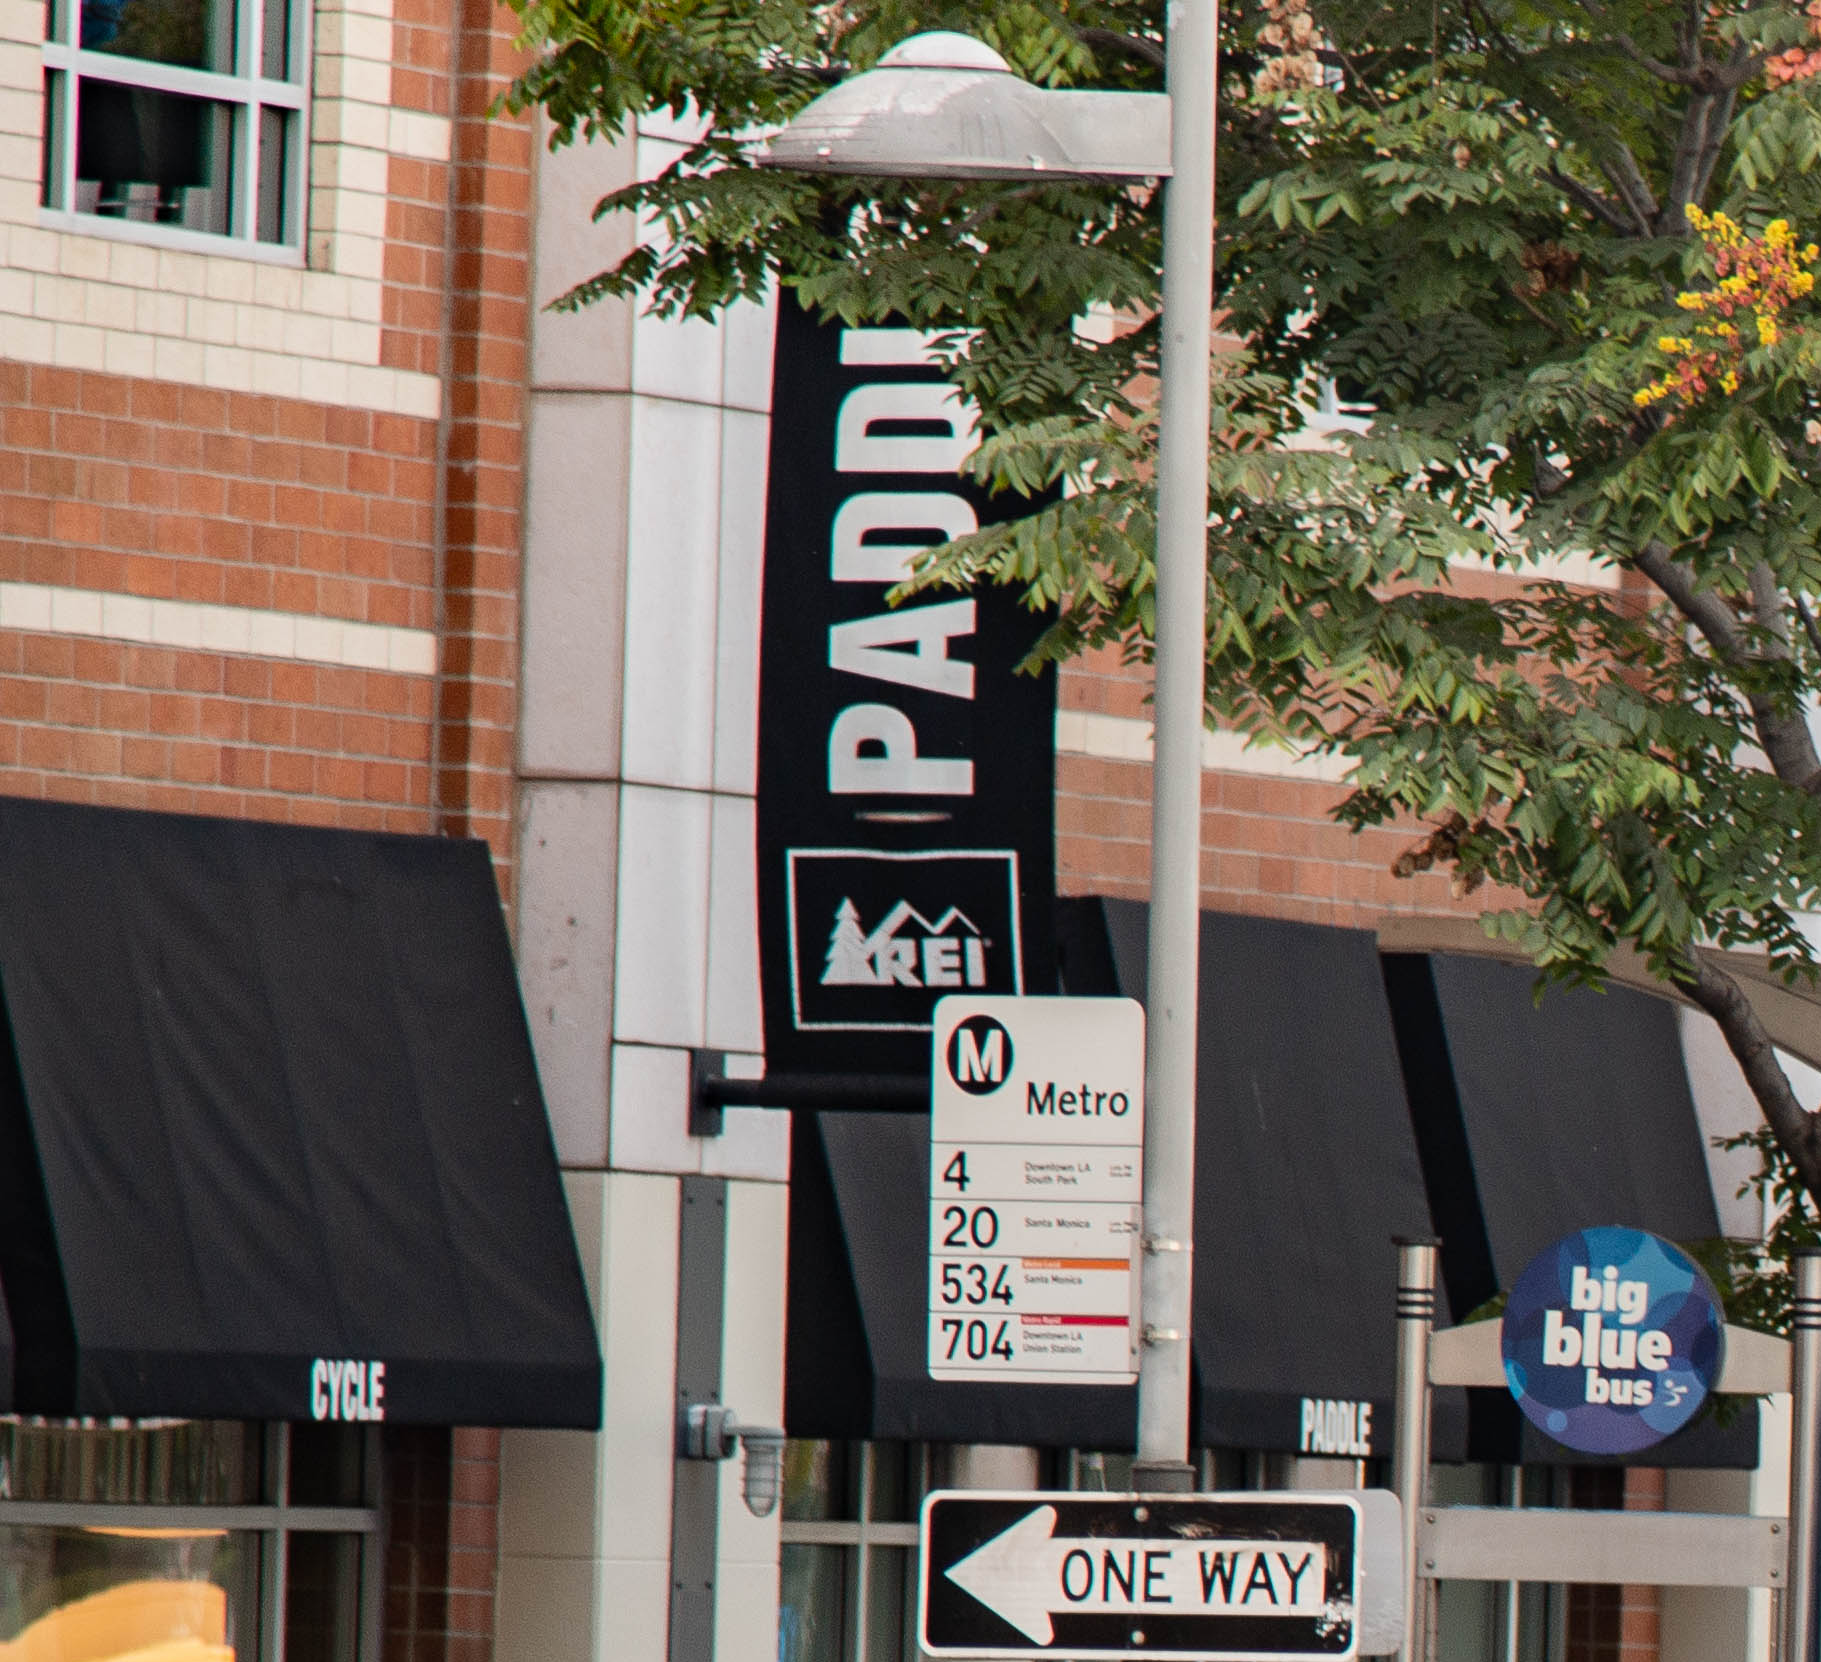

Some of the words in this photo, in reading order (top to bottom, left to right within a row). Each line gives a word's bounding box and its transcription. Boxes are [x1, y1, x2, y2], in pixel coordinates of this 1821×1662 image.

[876, 937, 986, 987] REI
[1026, 1081, 1129, 1117] Metro
[943, 1150, 970, 1191] 4
[1024, 1161, 1075, 1172] Downtown
[1078, 1162, 1091, 1173] LA
[1024, 1174, 1053, 1185] South
[1057, 1175, 1078, 1185] Park
[942, 1205, 999, 1249] 20
[1024, 1216, 1053, 1228] Santa
[1056, 1217, 1090, 1228] Monica
[941, 1263, 1014, 1305] 534
[1571, 1265, 1648, 1325] big
[941, 1319, 1014, 1361] 704
[1543, 1309, 1672, 1372] blue
[311, 1358, 386, 1421] CYCLE
[1585, 1367, 1653, 1406] bus
[1300, 1397, 1372, 1456] PADDLE
[1060, 1549, 1173, 1604] ONE
[1198, 1551, 1313, 1606] WAY
